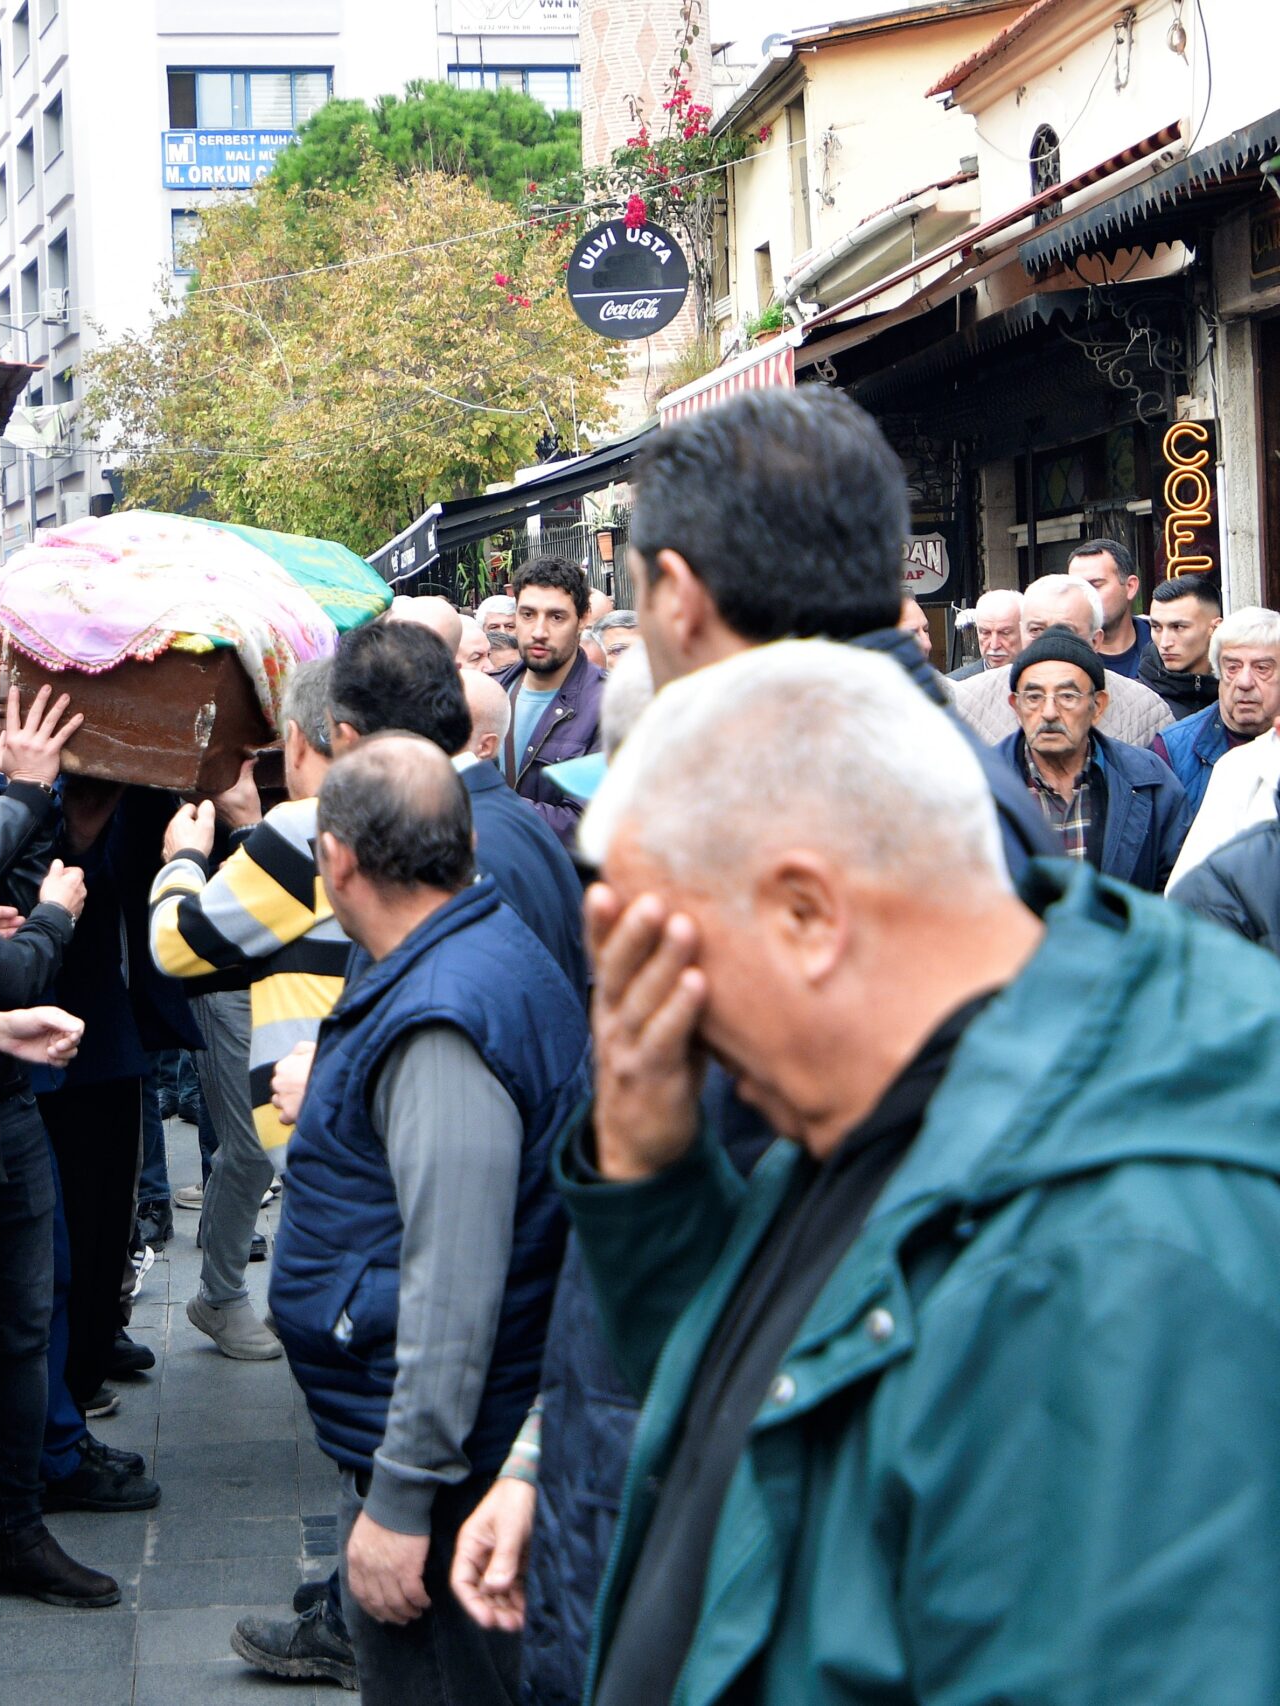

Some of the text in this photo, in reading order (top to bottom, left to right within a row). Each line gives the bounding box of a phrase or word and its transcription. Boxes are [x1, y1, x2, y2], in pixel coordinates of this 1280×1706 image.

[199, 135, 256, 145] SERBEST
[226, 148, 255, 161] MALİ
[166, 166, 185, 183] M.
[188, 165, 251, 183] ORKUN
[626, 228, 672, 265] USTA
